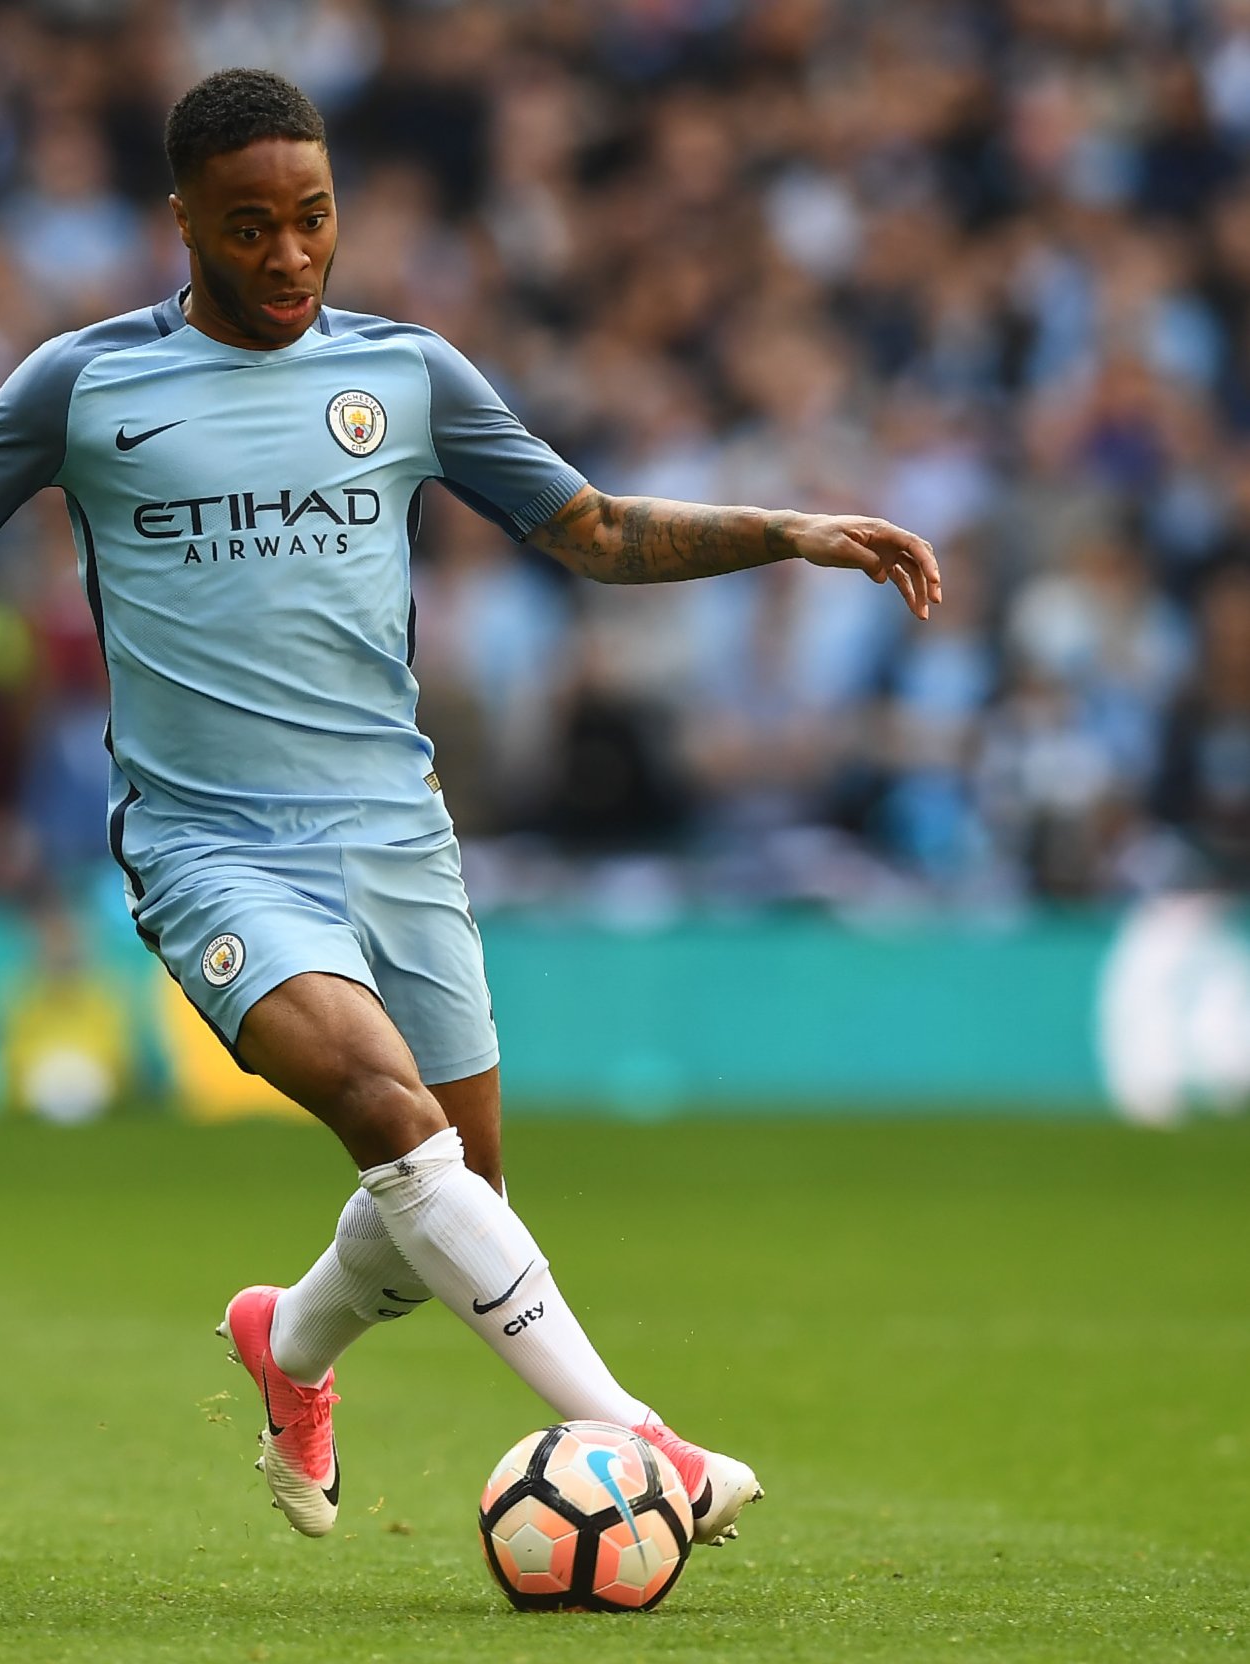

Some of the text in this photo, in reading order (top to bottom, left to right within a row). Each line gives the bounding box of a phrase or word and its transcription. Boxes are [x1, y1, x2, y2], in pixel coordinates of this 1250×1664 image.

[333, 394, 381, 416] MANCHESTER
[351, 444, 366, 452] CITY
[133, 488, 380, 539] ETIHAD
[184, 533, 348, 564] AIRWAYS
[204, 937, 234, 969] MANCHESTER
[503, 1301, 544, 1336] City
